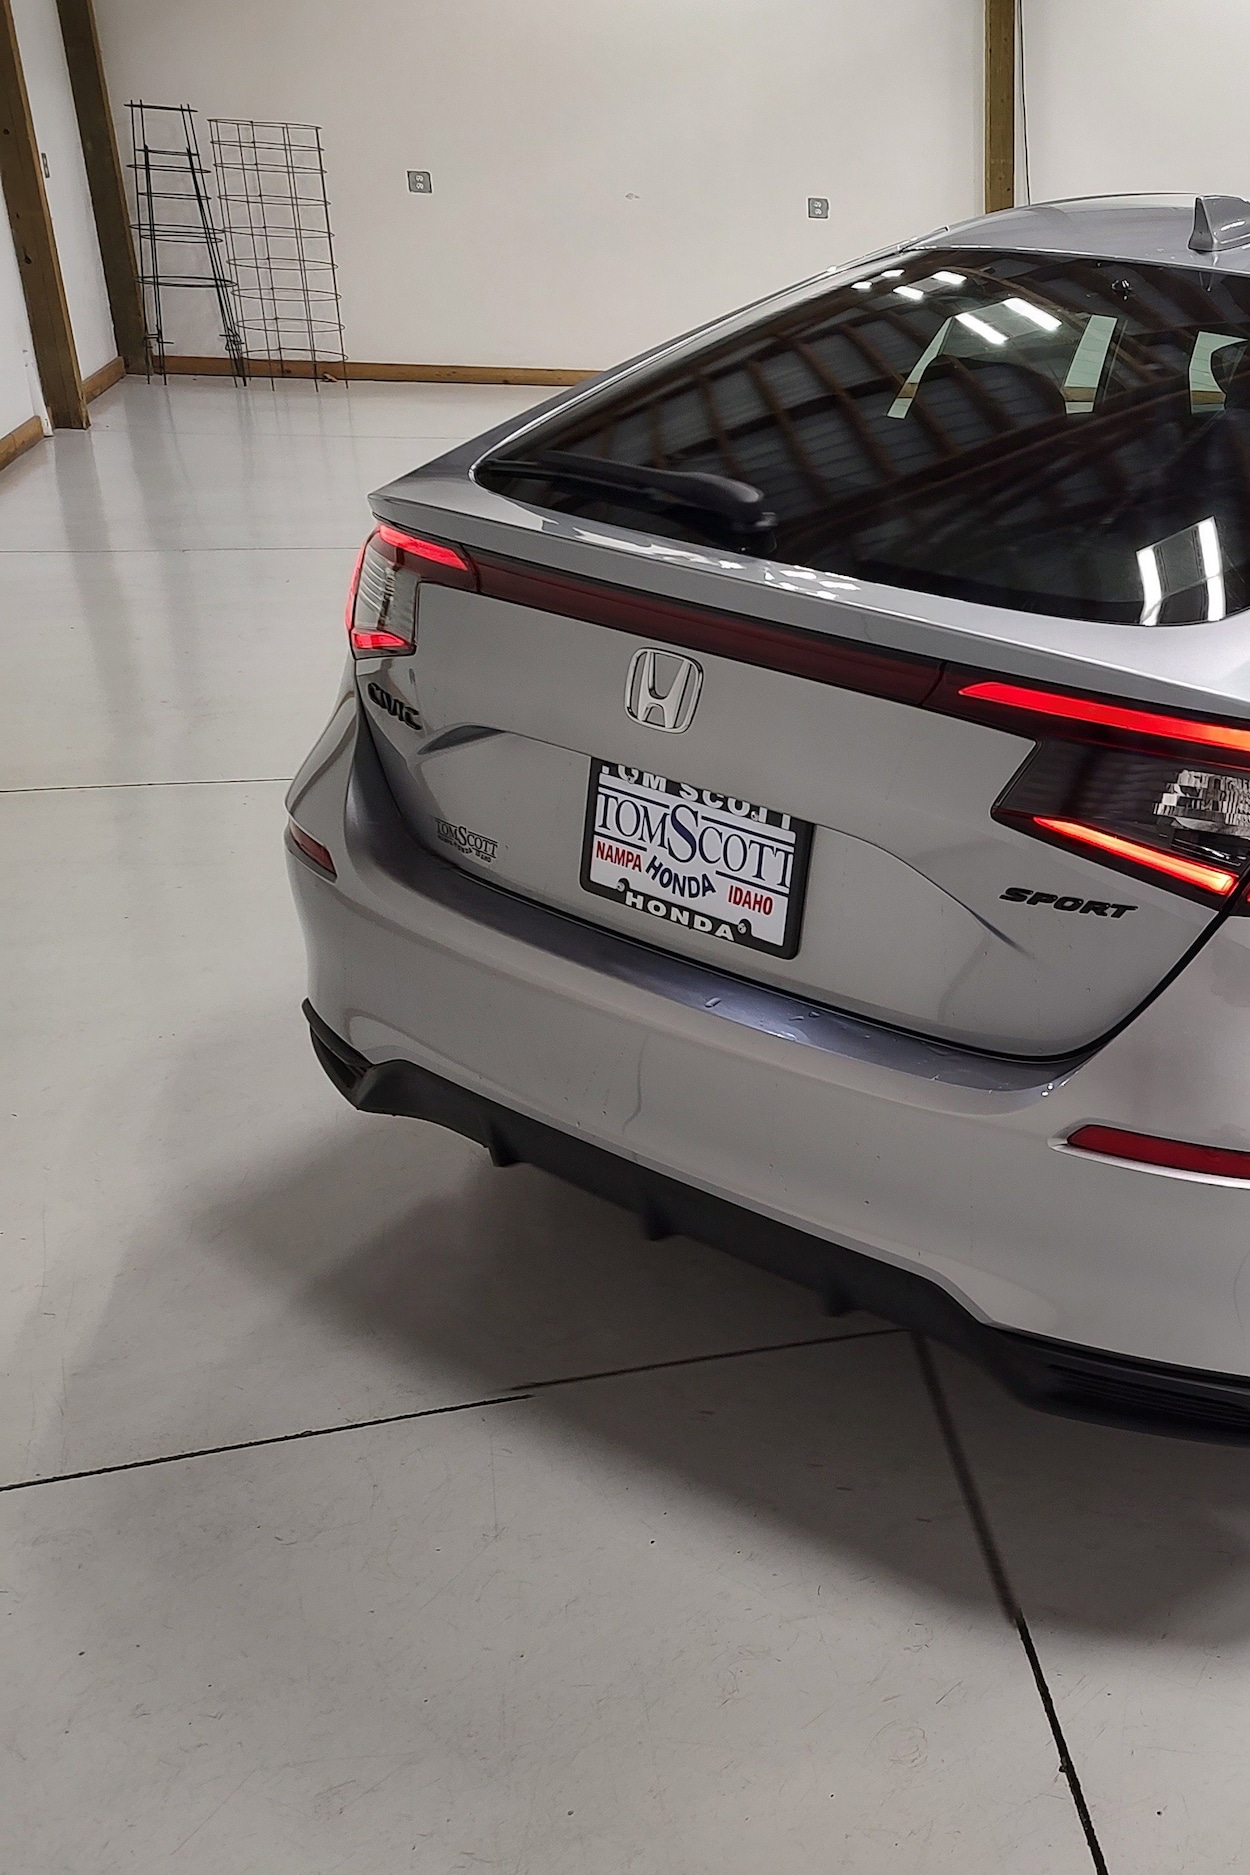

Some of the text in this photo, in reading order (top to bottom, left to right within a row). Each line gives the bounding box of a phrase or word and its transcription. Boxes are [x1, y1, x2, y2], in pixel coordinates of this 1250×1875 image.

[368, 682, 422, 730] CIVIC
[596, 841, 773, 915] NAMPA HONDA IDAHO
[998, 887, 1138, 918] SPORT
[625, 891, 735, 941] HONDA
